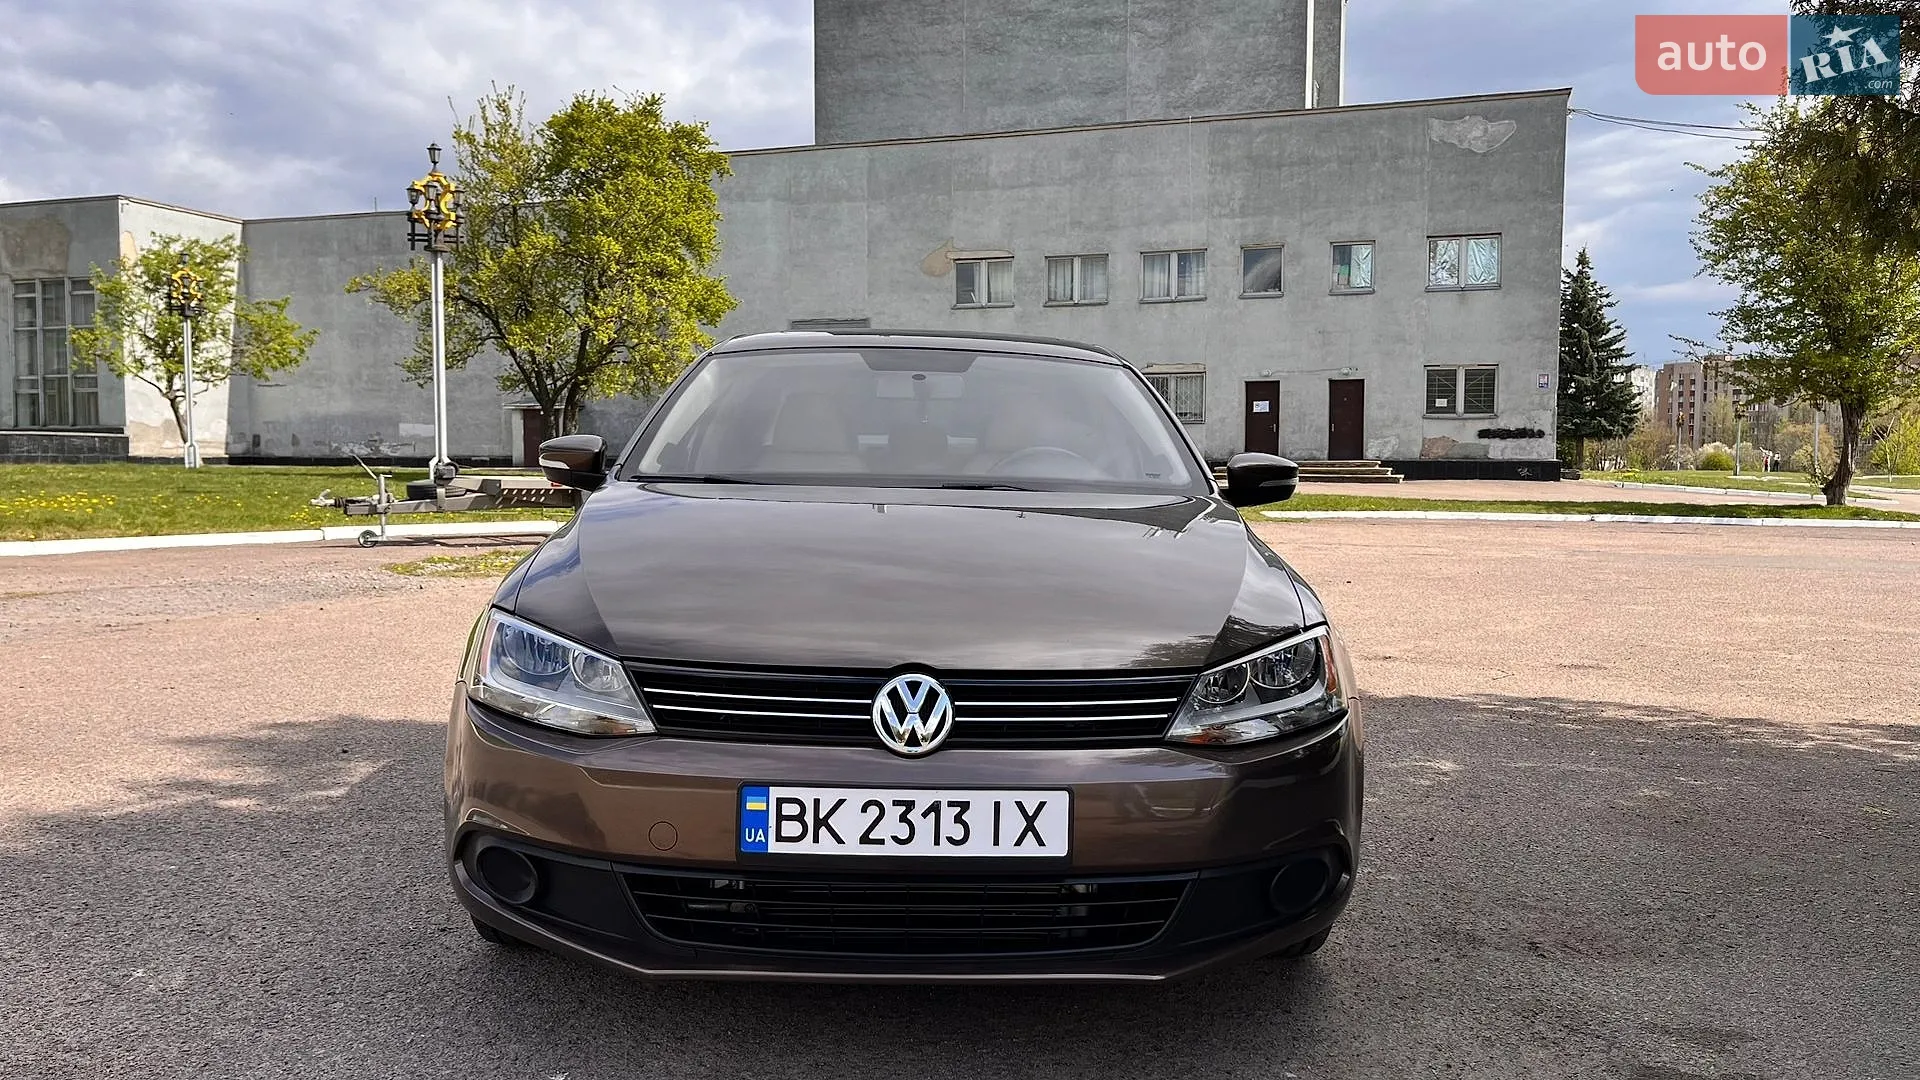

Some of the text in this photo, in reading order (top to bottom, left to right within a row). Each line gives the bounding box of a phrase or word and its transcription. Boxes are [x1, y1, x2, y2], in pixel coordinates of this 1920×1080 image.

[876, 676, 951, 751] VW
[745, 828, 766, 843] UA
[775, 796, 1048, 848] BK 2313 IX
